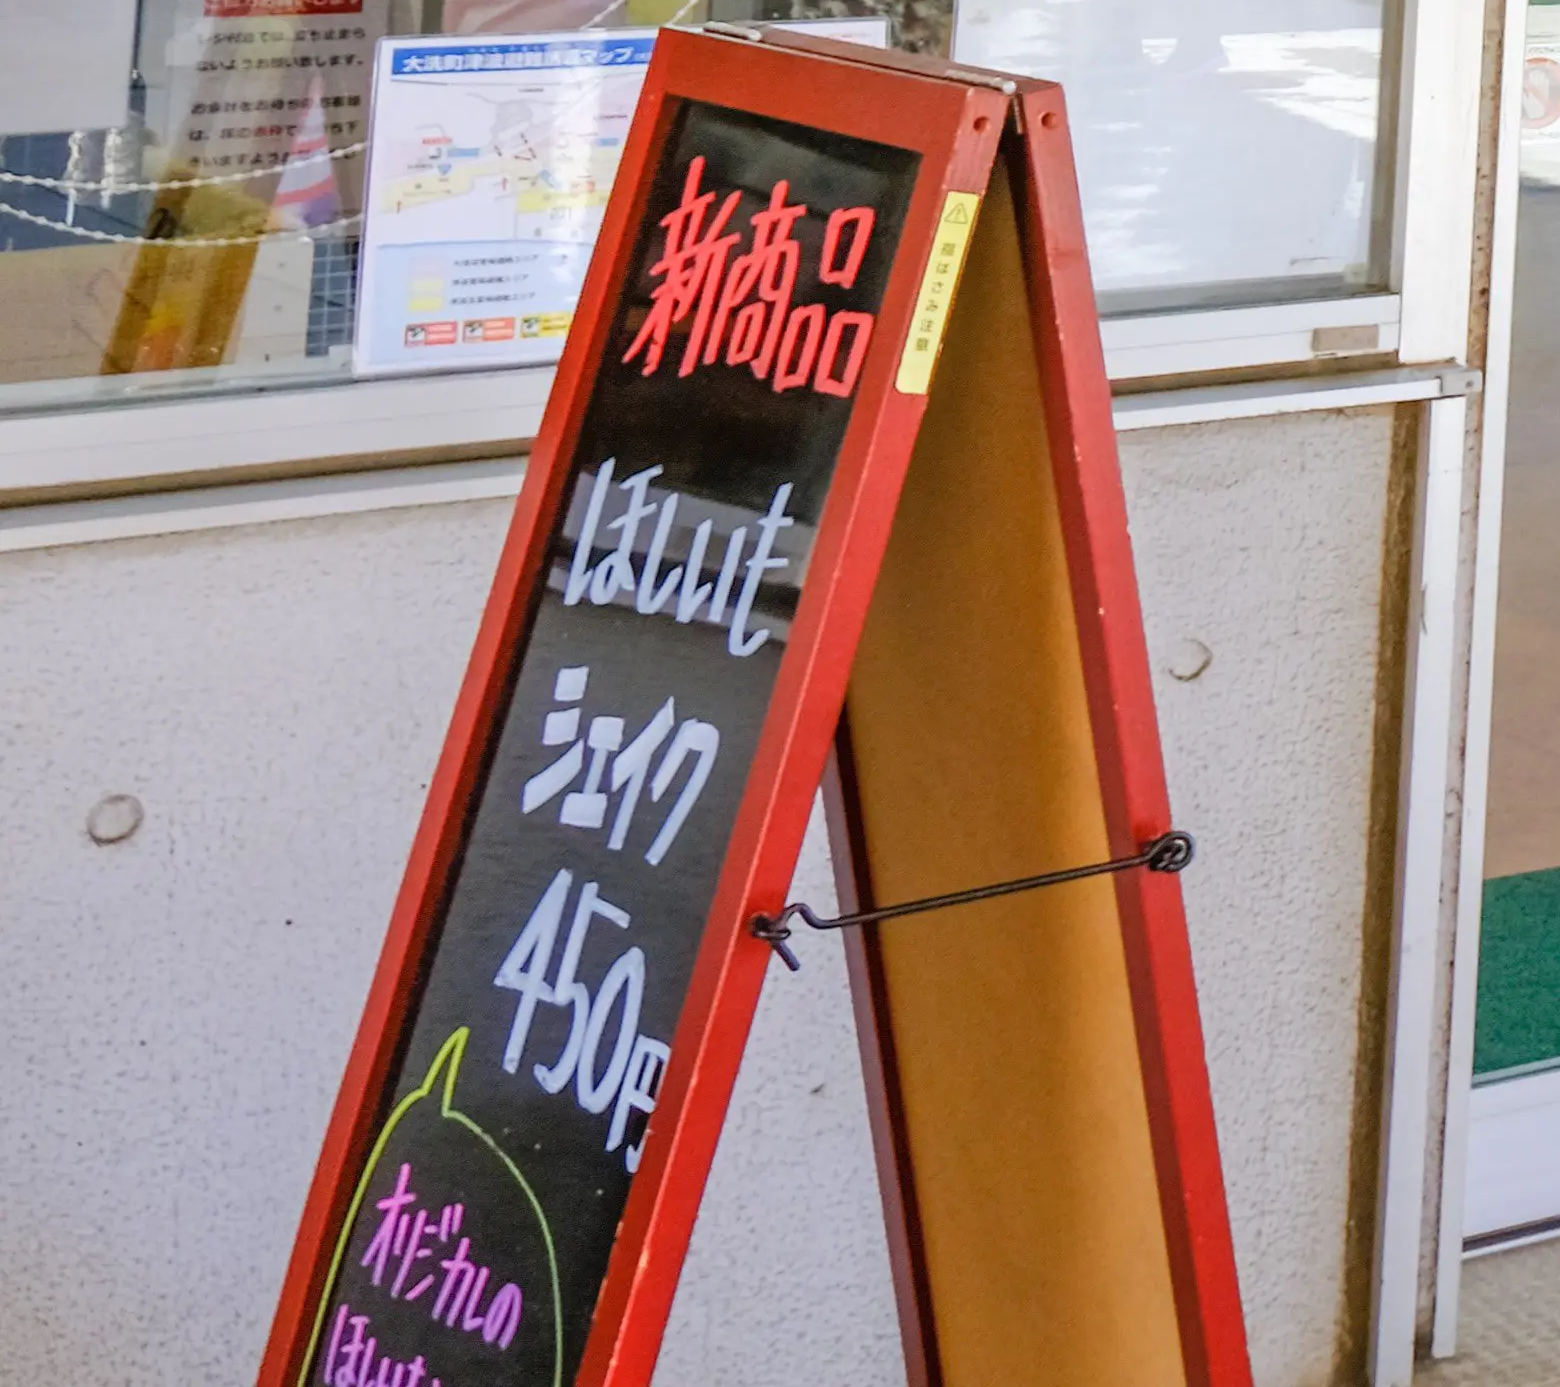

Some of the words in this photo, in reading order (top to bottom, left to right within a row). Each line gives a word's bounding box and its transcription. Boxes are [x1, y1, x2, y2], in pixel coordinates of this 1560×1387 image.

[622, 155, 875, 398] 新商品
[563, 458, 796, 658] ほしいも
[521, 665, 720, 867] シェイク
[493, 868, 672, 1175] 450円
